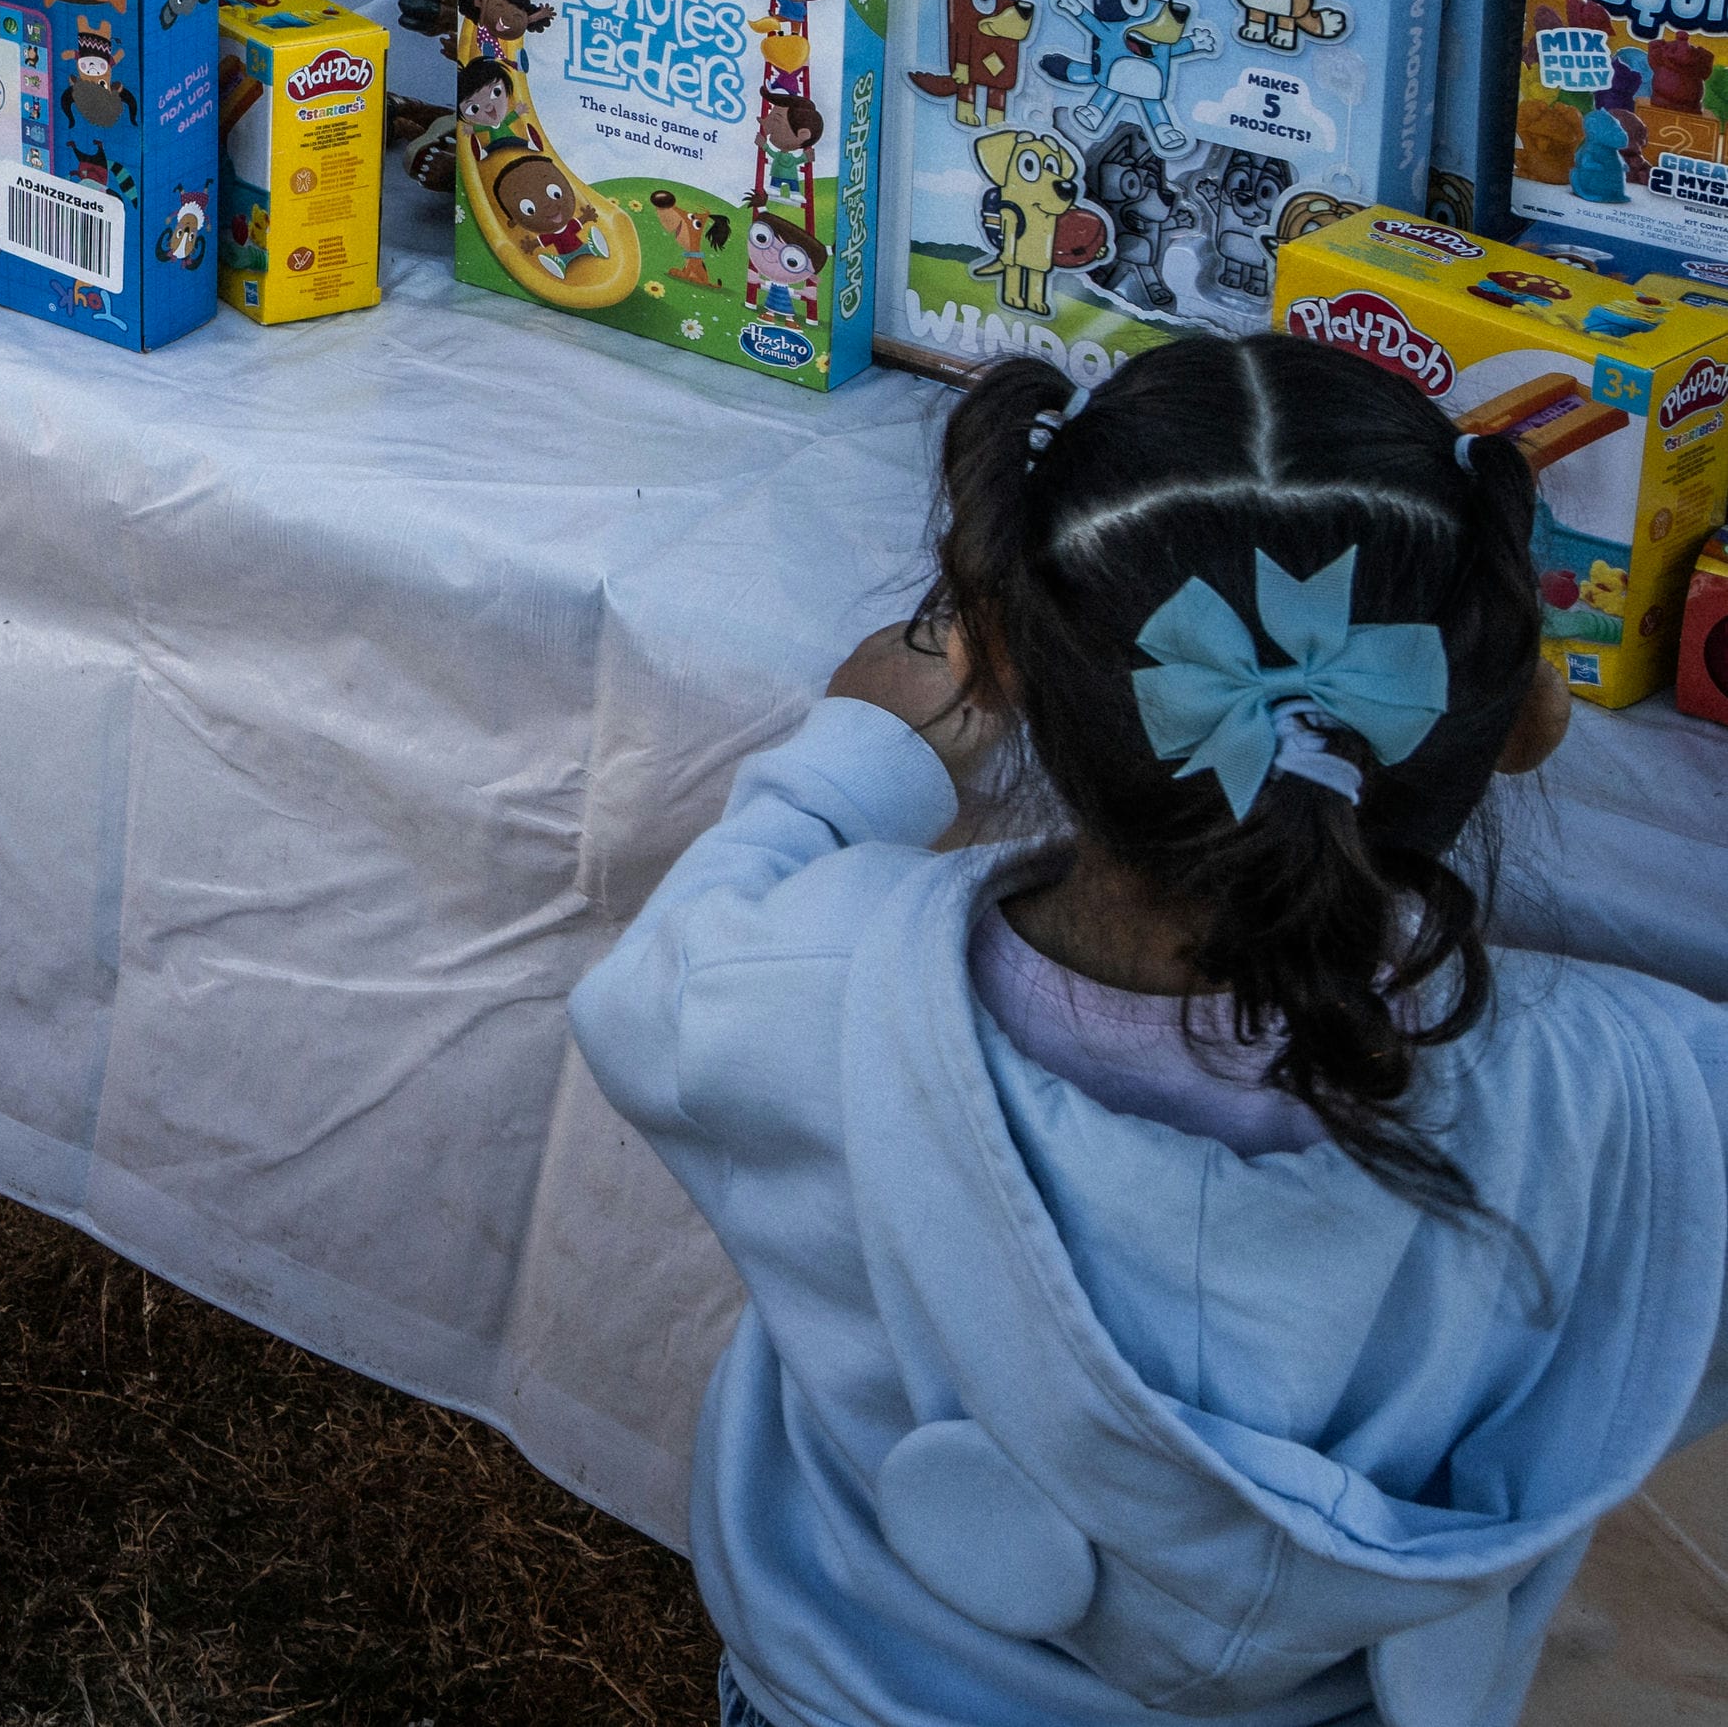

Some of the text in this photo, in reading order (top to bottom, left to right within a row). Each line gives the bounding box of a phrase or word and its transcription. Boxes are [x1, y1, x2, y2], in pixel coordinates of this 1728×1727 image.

[591, 15, 622, 39] and
[1541, 32, 1606, 52] MIX
[289, 57, 370, 96] Play-Doh
[565, 4, 745, 123] Ladders
[1544, 55, 1608, 69] POUR
[158, 62, 209, 109] find me?
[1545, 70, 1612, 87] PLAY
[160, 81, 211, 126] can you
[1262, 93, 1281, 120] 5
[1399, 26, 1423, 170] WINDOW
[580, 95, 718, 143] The classic game of
[1230, 114, 1312, 144] PROJECTS!
[596, 122, 704, 161] ups and downs!
[1651, 169, 1673, 195] 2
[1661, 155, 1728, 180] CREA
[16, 175, 104, 214] spPBZBZNFGV
[840, 69, 874, 321] Chutes Ladders
[1582, 210, 1603, 220] GLUE
[1606, 215, 1626, 225] PENS
[1629, 220, 1645, 229] 0.35
[1619, 211, 1656, 223] MYSTERY
[1658, 219, 1687, 232] MOLDS
[1684, 206, 1722, 217] REUSABLE
[1684, 219, 1698, 227] KIT
[1385, 221, 1481, 256] Play-Doh
[1647, 232, 1678, 245] SECRET
[50, 278, 128, 332] Toyk
[742, 324, 808, 356] Hasbro
[754, 342, 797, 366] Gaming
[906, 289, 1129, 389] WINDO
[1292, 300, 1448, 391] Play-Doh
[1602, 371, 1642, 400] 3+
